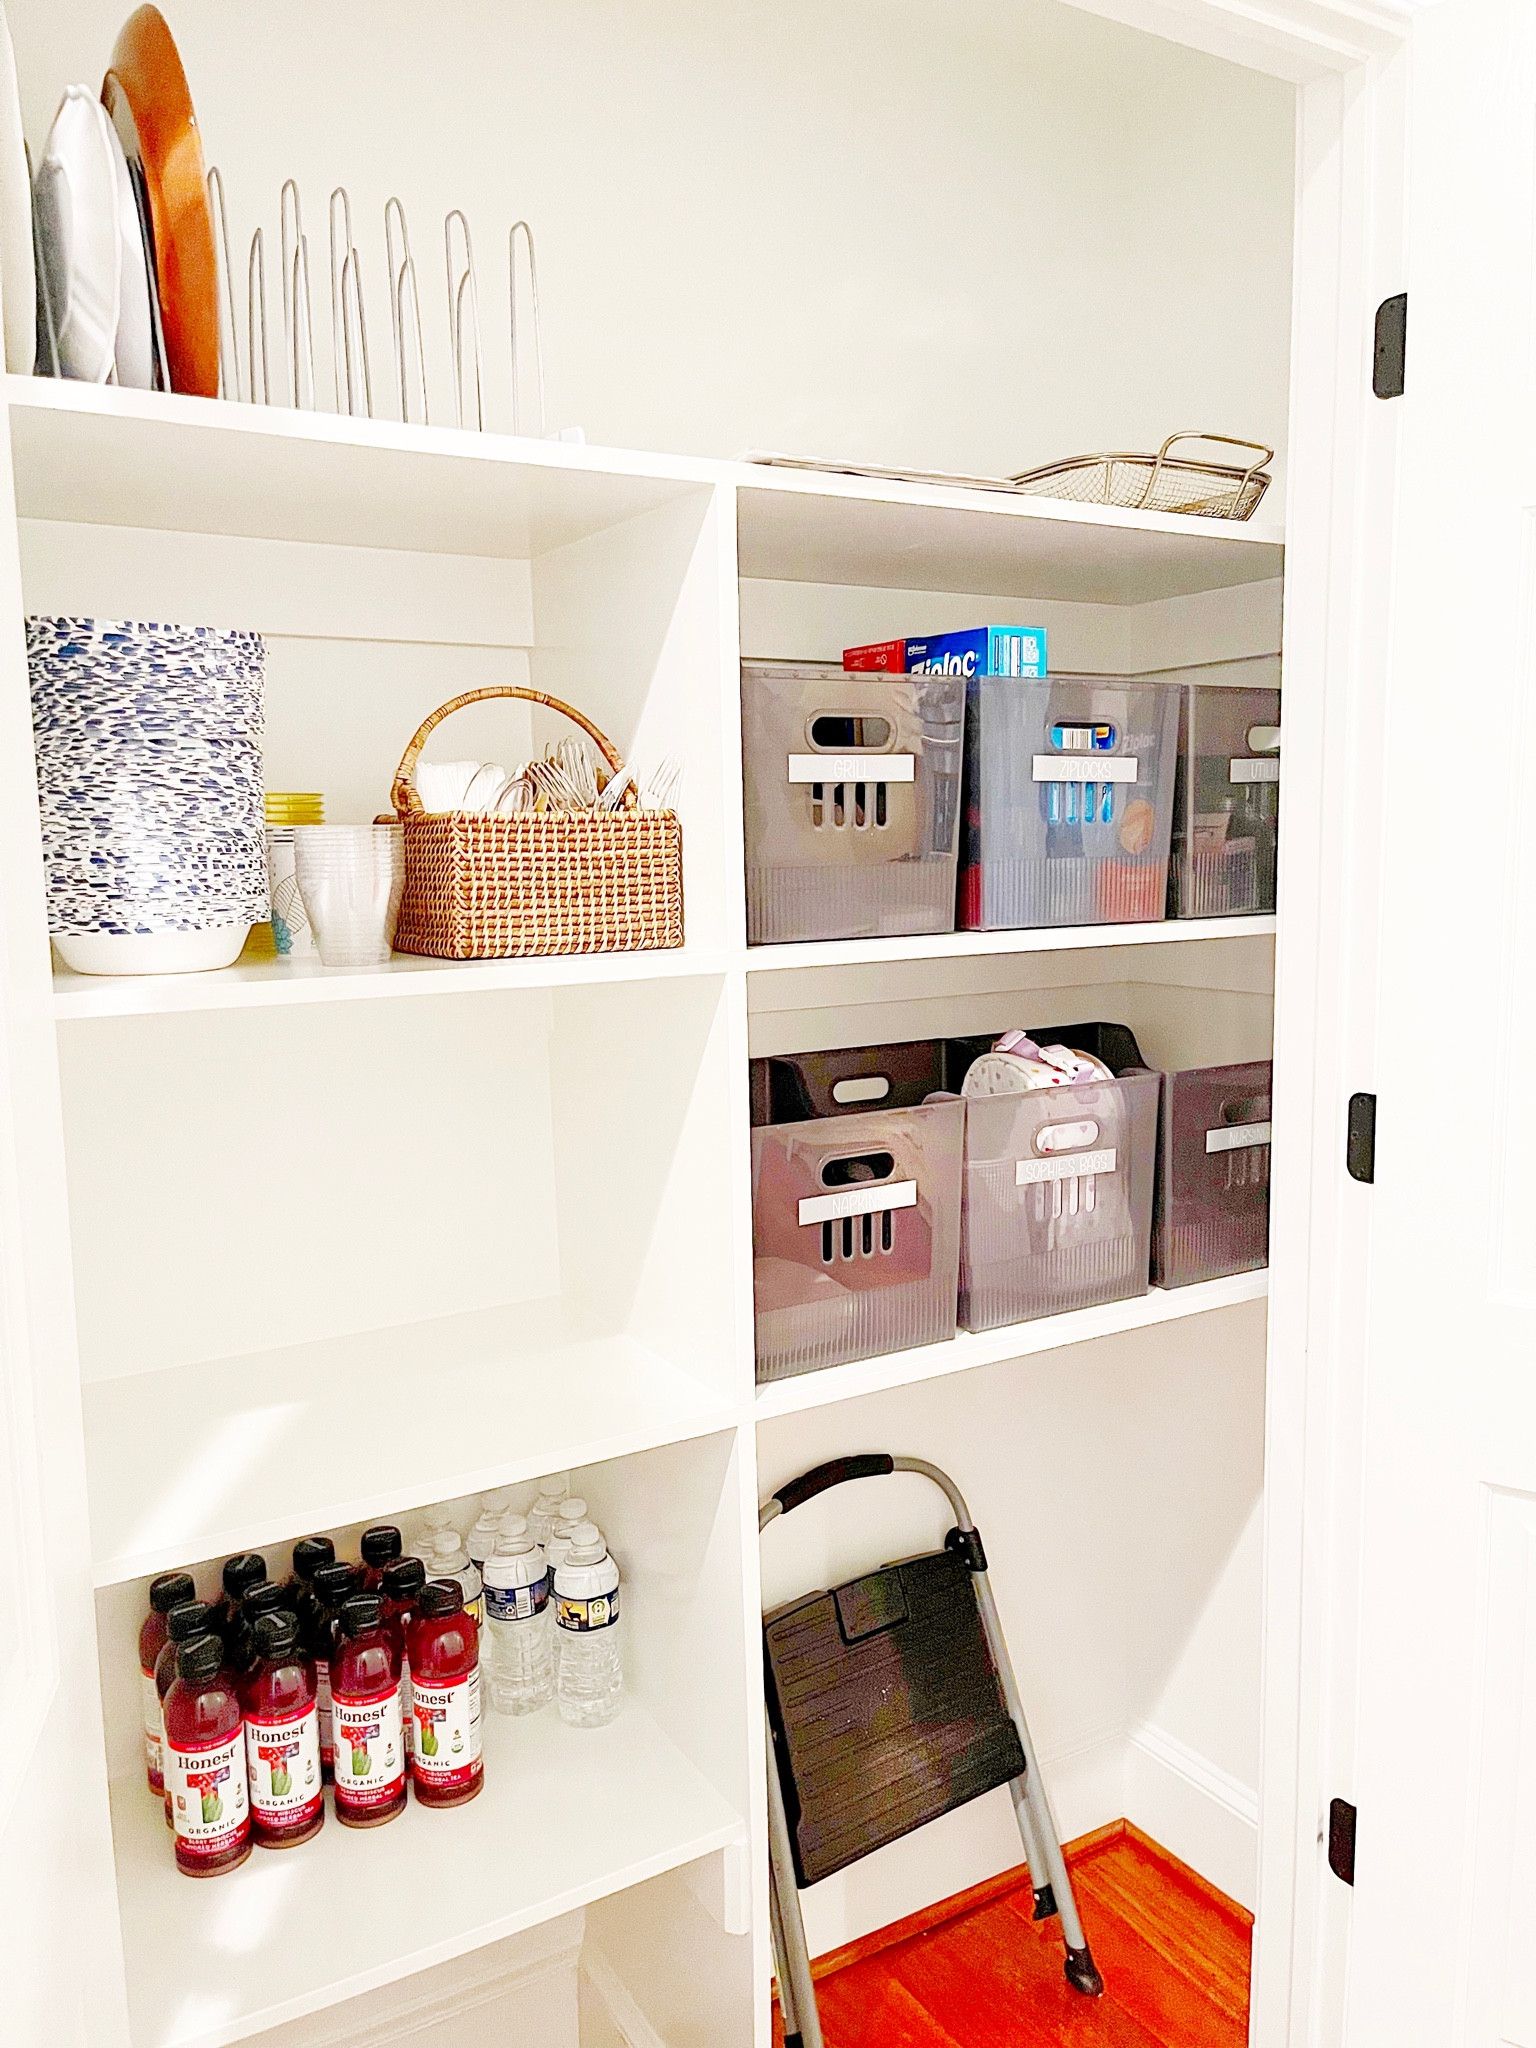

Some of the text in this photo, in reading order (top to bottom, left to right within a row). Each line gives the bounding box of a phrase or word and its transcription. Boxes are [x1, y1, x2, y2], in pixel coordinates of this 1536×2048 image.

[833, 759, 871, 779] GRILL
[1059, 760, 1112, 779] ZIPLOCKS
[1229, 1125, 1270, 1147] NURSING
[1025, 1154, 1108, 1181] SOPHIE'S BAGS
[833, 1191, 887, 1216] NAPKINS
[335, 1705, 388, 1723] Honest
[251, 1721, 307, 1743] Honest
[178, 1744, 237, 1770] Honest
[340, 1776, 384, 1787] ORGANIC
[259, 1794, 305, 1806] ORGANIC
[188, 1818, 236, 1834] ORGANIC
